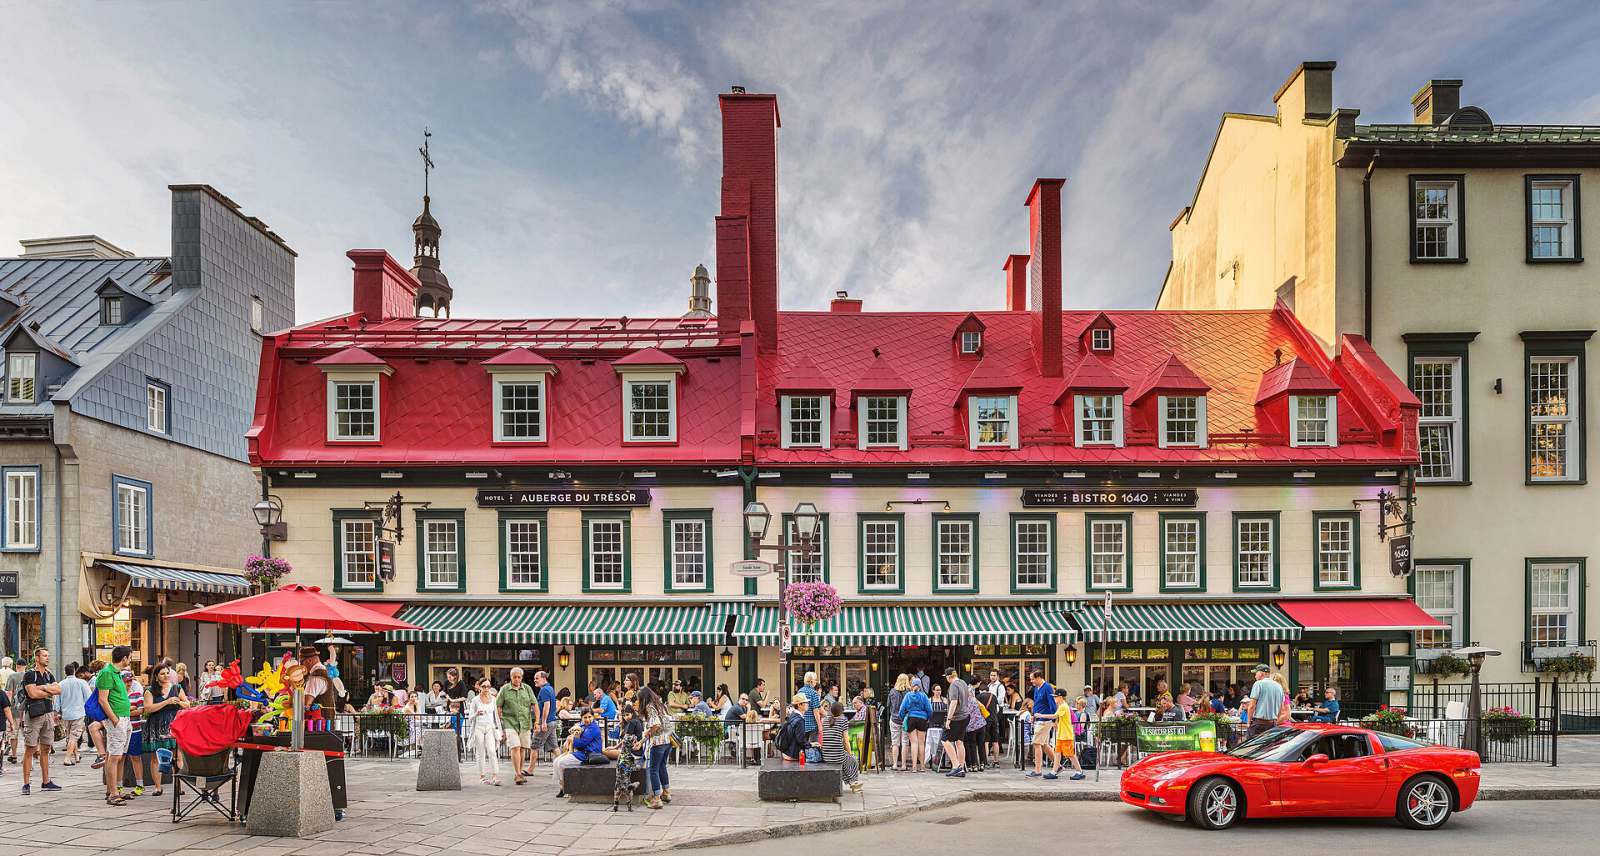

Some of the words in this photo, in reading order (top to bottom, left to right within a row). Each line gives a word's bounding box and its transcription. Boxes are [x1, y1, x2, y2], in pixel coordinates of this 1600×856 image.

[520, 493, 572, 502] AUBERGE
[575, 493, 590, 502] DU
[593, 491, 637, 502] TRÉSOR
[1072, 493, 1117, 503] BISTRO
[1121, 493, 1149, 503] 1640
[1394, 549, 1409, 559] 1640
